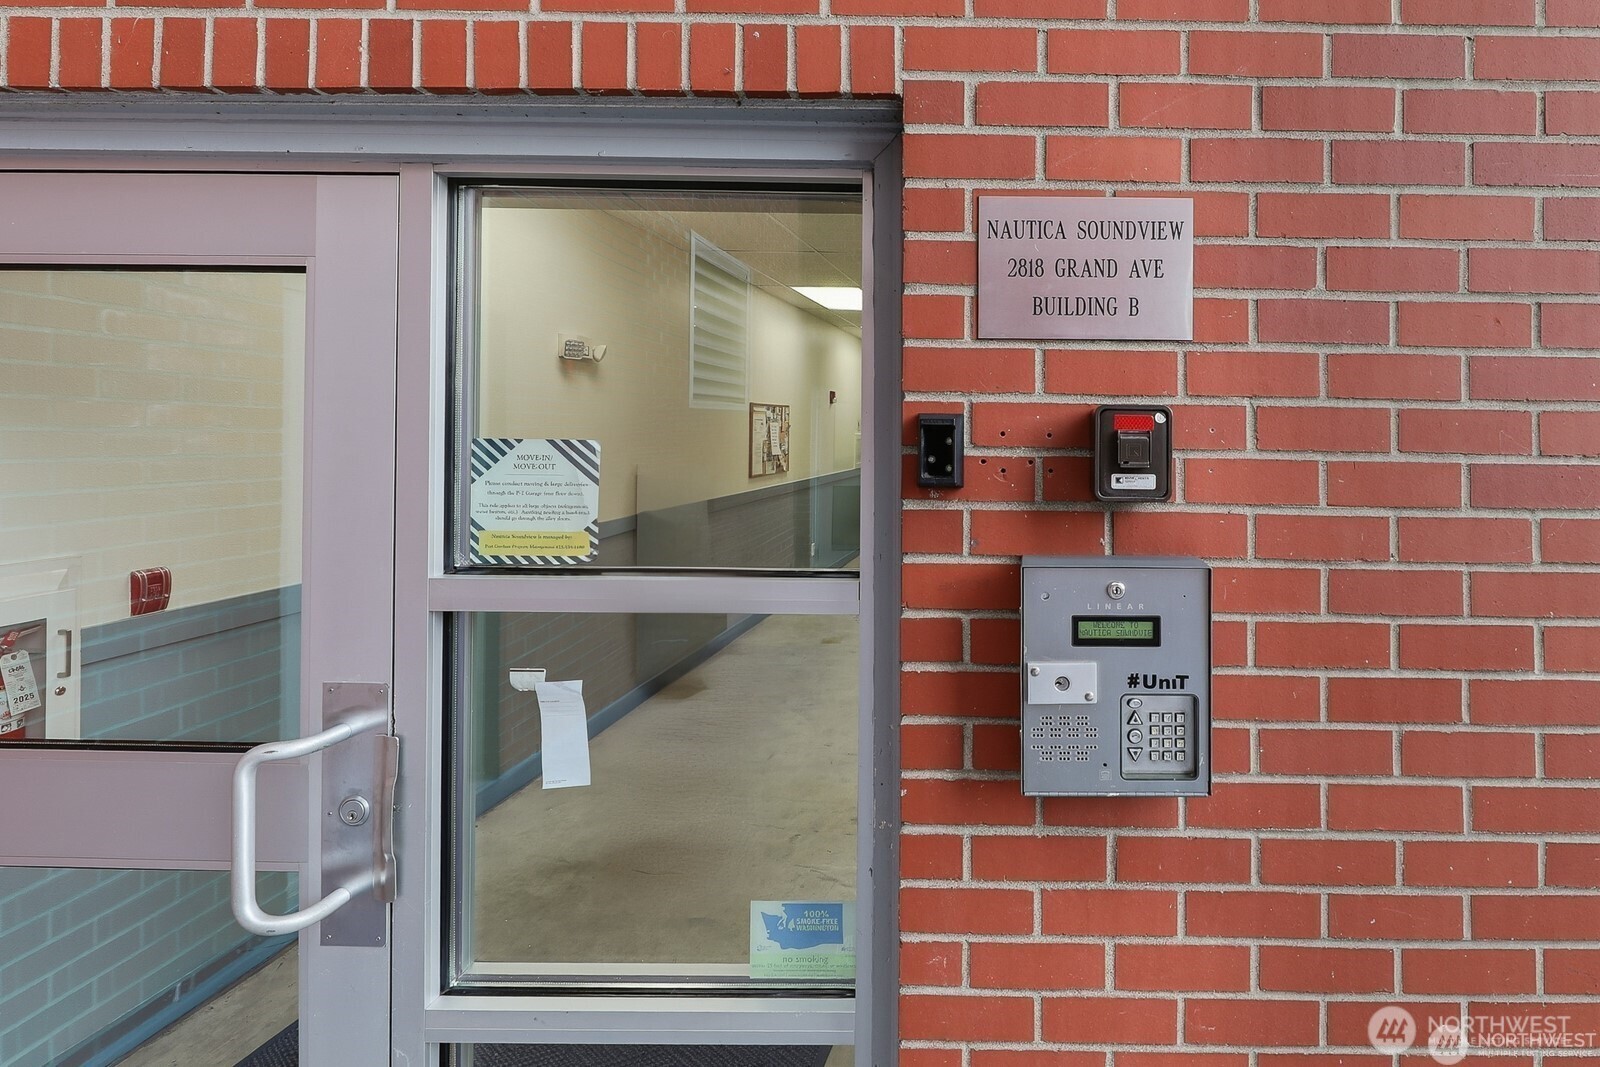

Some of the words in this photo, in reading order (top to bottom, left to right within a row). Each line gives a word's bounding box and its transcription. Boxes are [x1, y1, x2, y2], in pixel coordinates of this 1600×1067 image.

[987, 220, 1067, 239] NAUTICA
[1077, 220, 1185, 240] SOUNDVIEW
[1007, 258, 1044, 278] 2818
[1055, 258, 1118, 278] GRAND
[1129, 259, 1165, 278] AVE
[1032, 296, 1118, 316] BUILDING
[1129, 297, 1139, 316] B
[1093, 621, 1125, 629] WELCOME
[1130, 621, 1139, 629] TO
[13, 692, 35, 704] 2025
[795, 955, 829, 965] smoking
